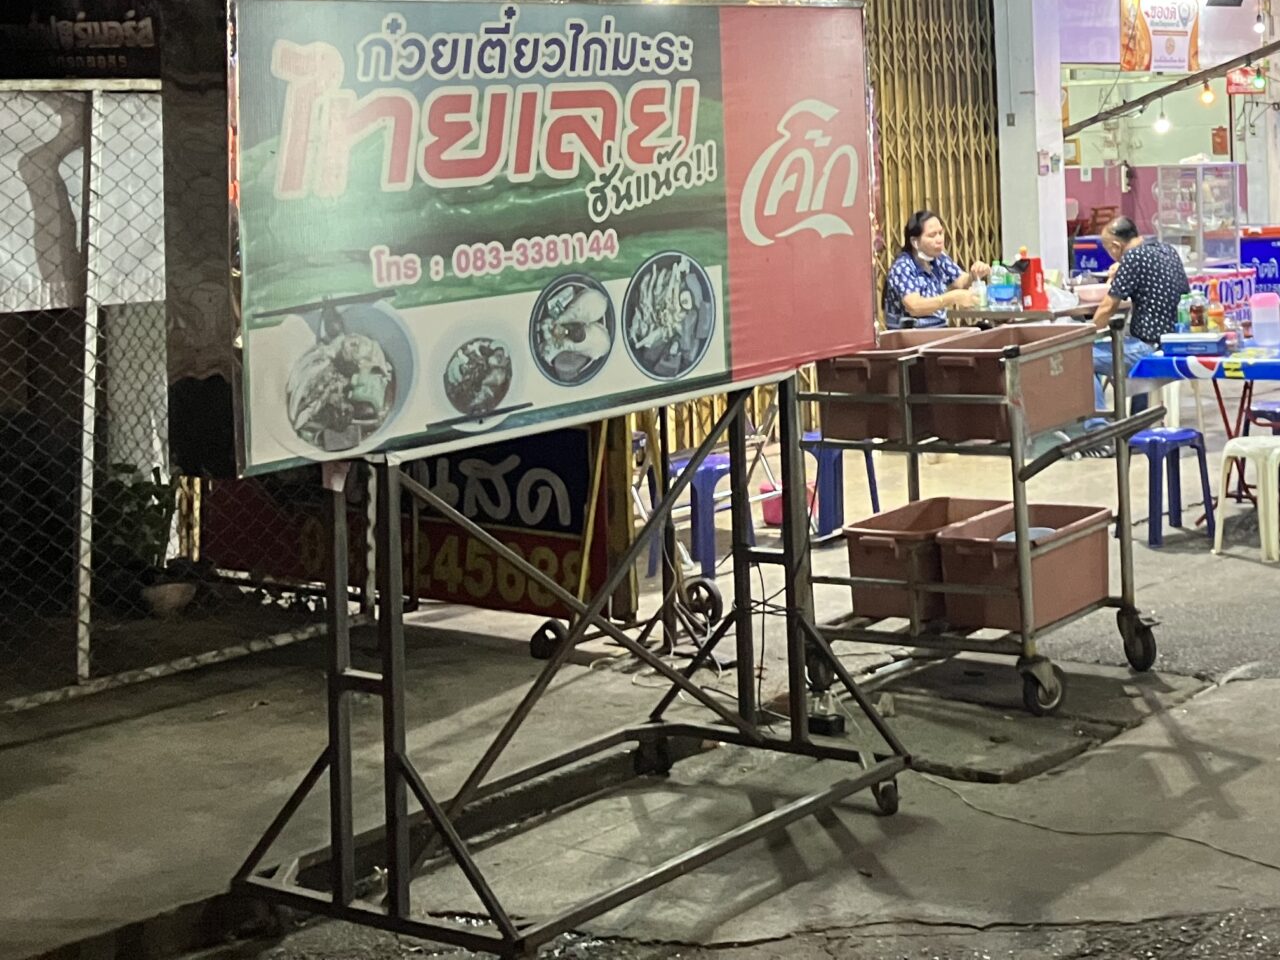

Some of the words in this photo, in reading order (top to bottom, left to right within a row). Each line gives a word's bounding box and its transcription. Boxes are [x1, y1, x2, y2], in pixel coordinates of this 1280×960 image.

[361, 5, 692, 78] ก๋วยเตี๋ยวไก่มะระ
[275, 42, 698, 196] ไทยเลย
[456, 232, 617, 274] 083-3381144
